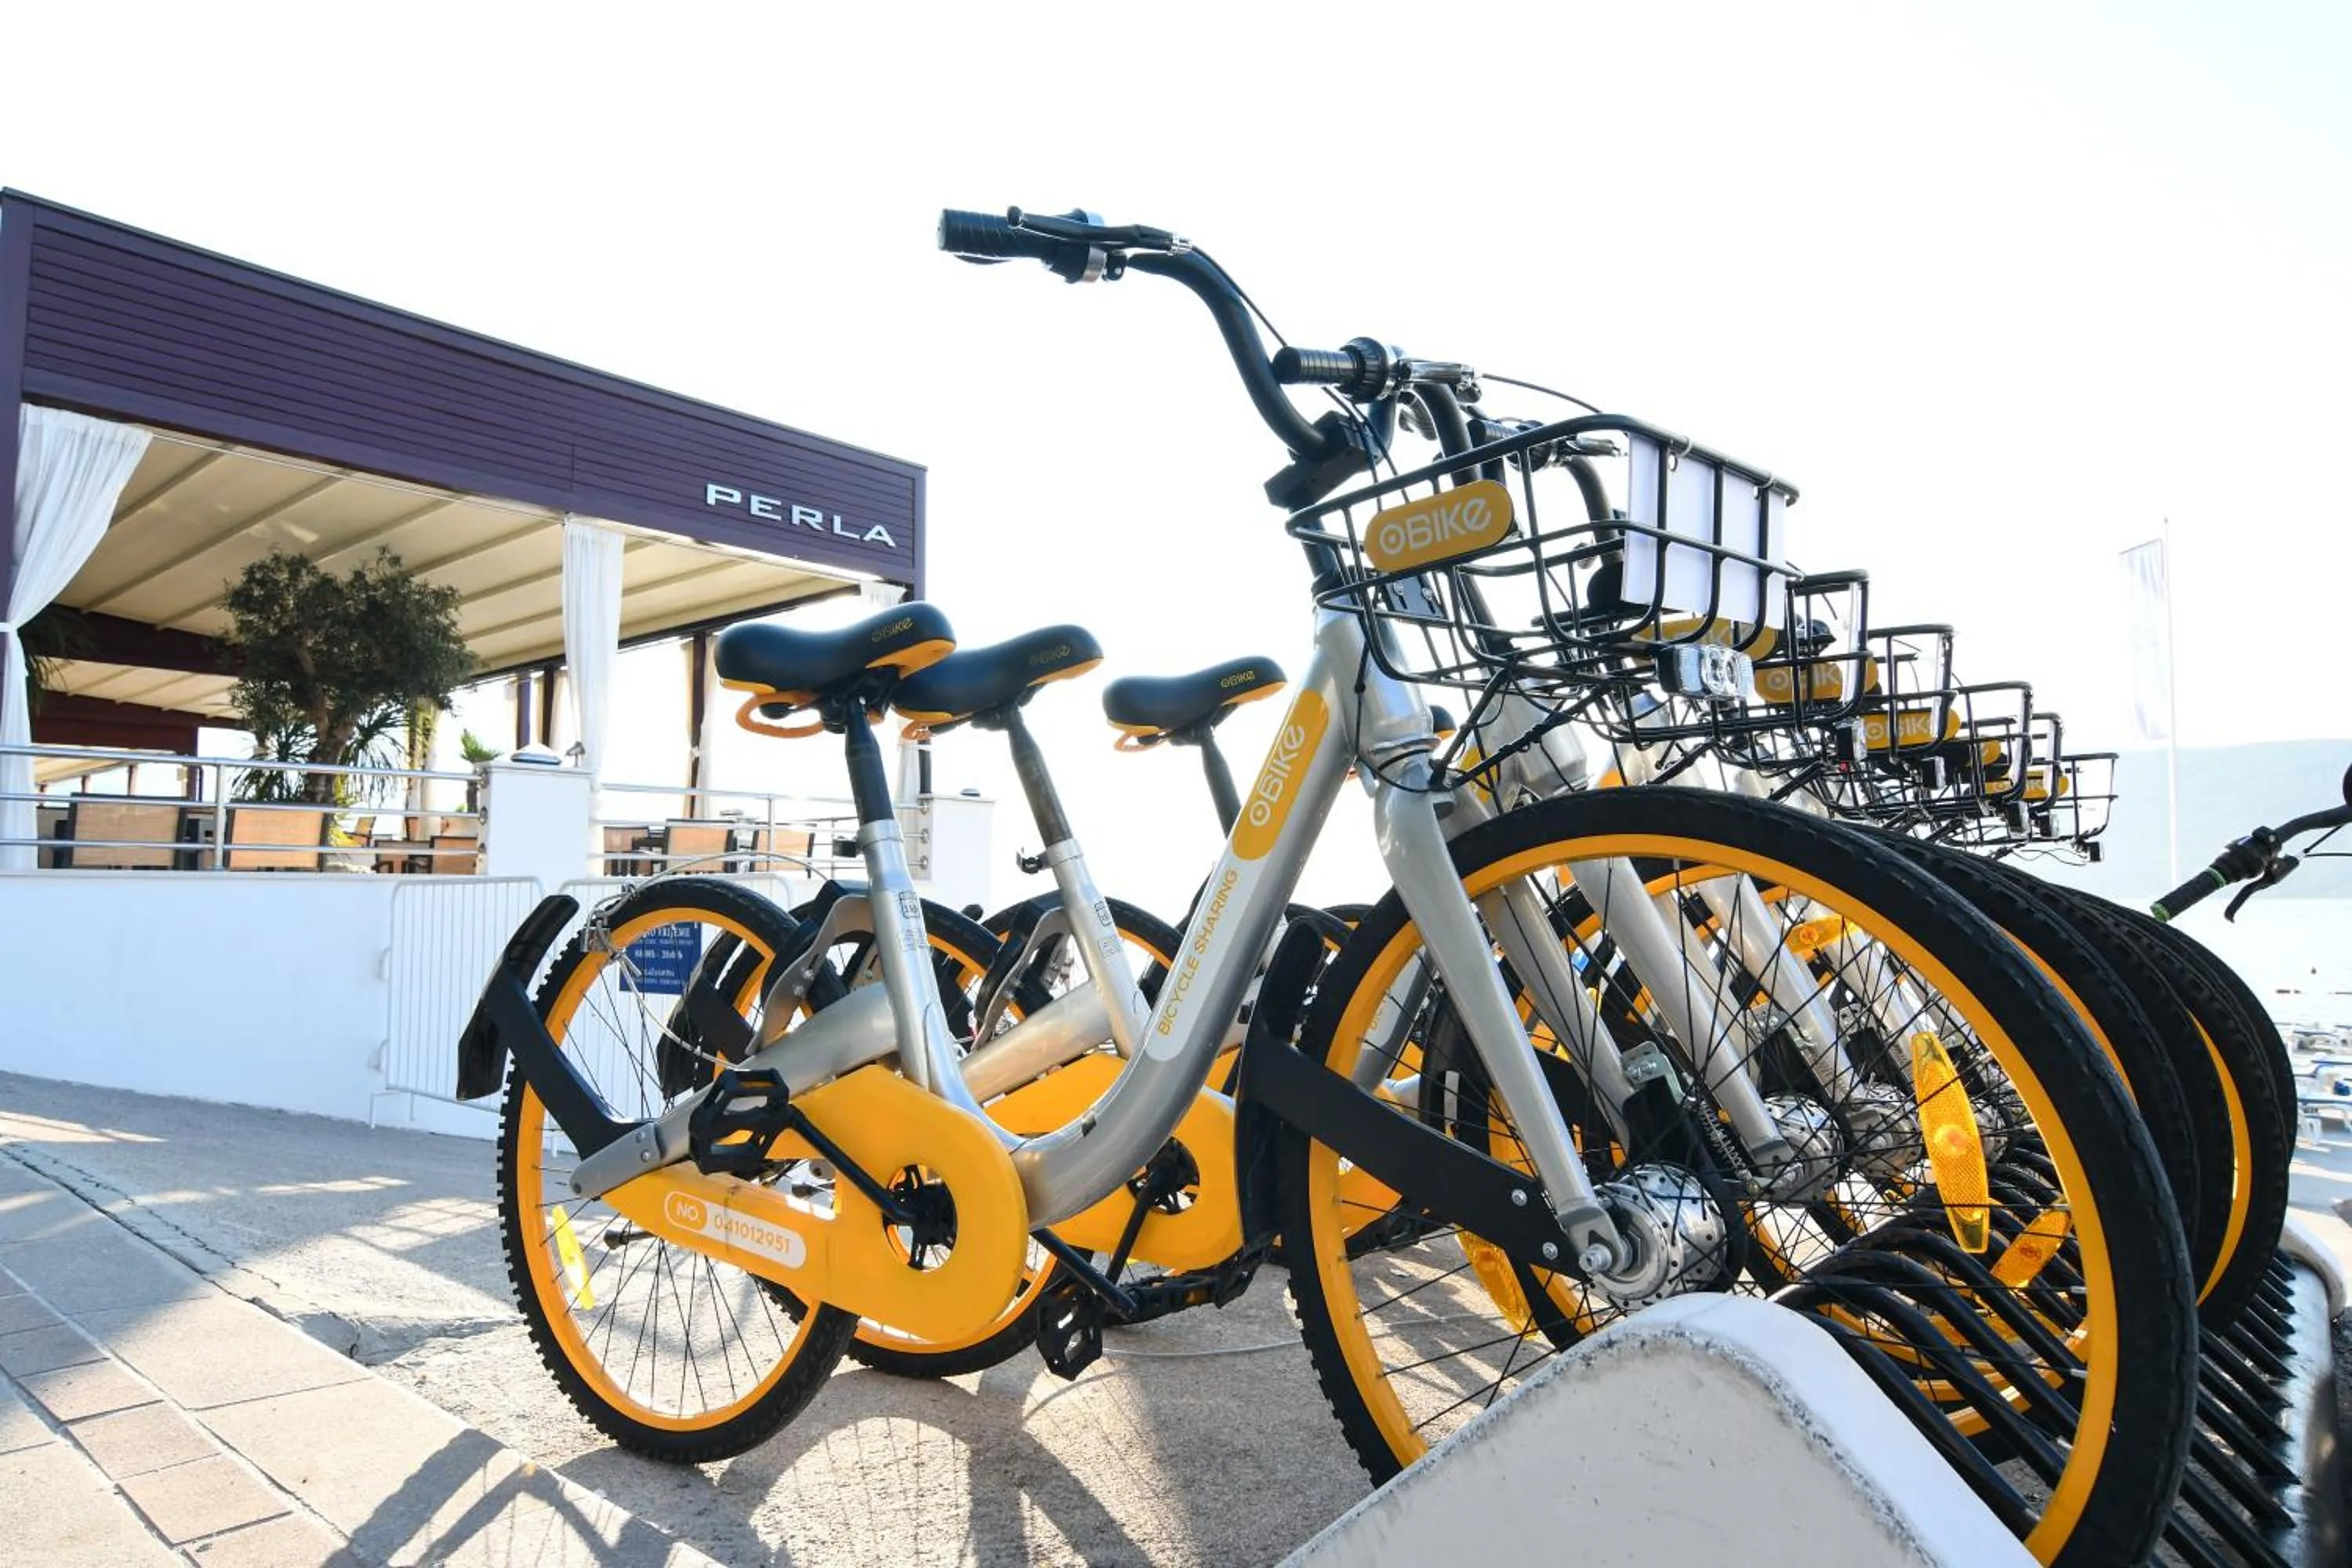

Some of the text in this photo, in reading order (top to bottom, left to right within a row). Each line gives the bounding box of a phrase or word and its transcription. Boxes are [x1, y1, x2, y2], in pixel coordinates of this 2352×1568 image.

[706, 483, 896, 548] PERLA
[1158, 869, 1239, 1036] BICYCLE SHARING
[714, 1214, 790, 1254] 041012951
